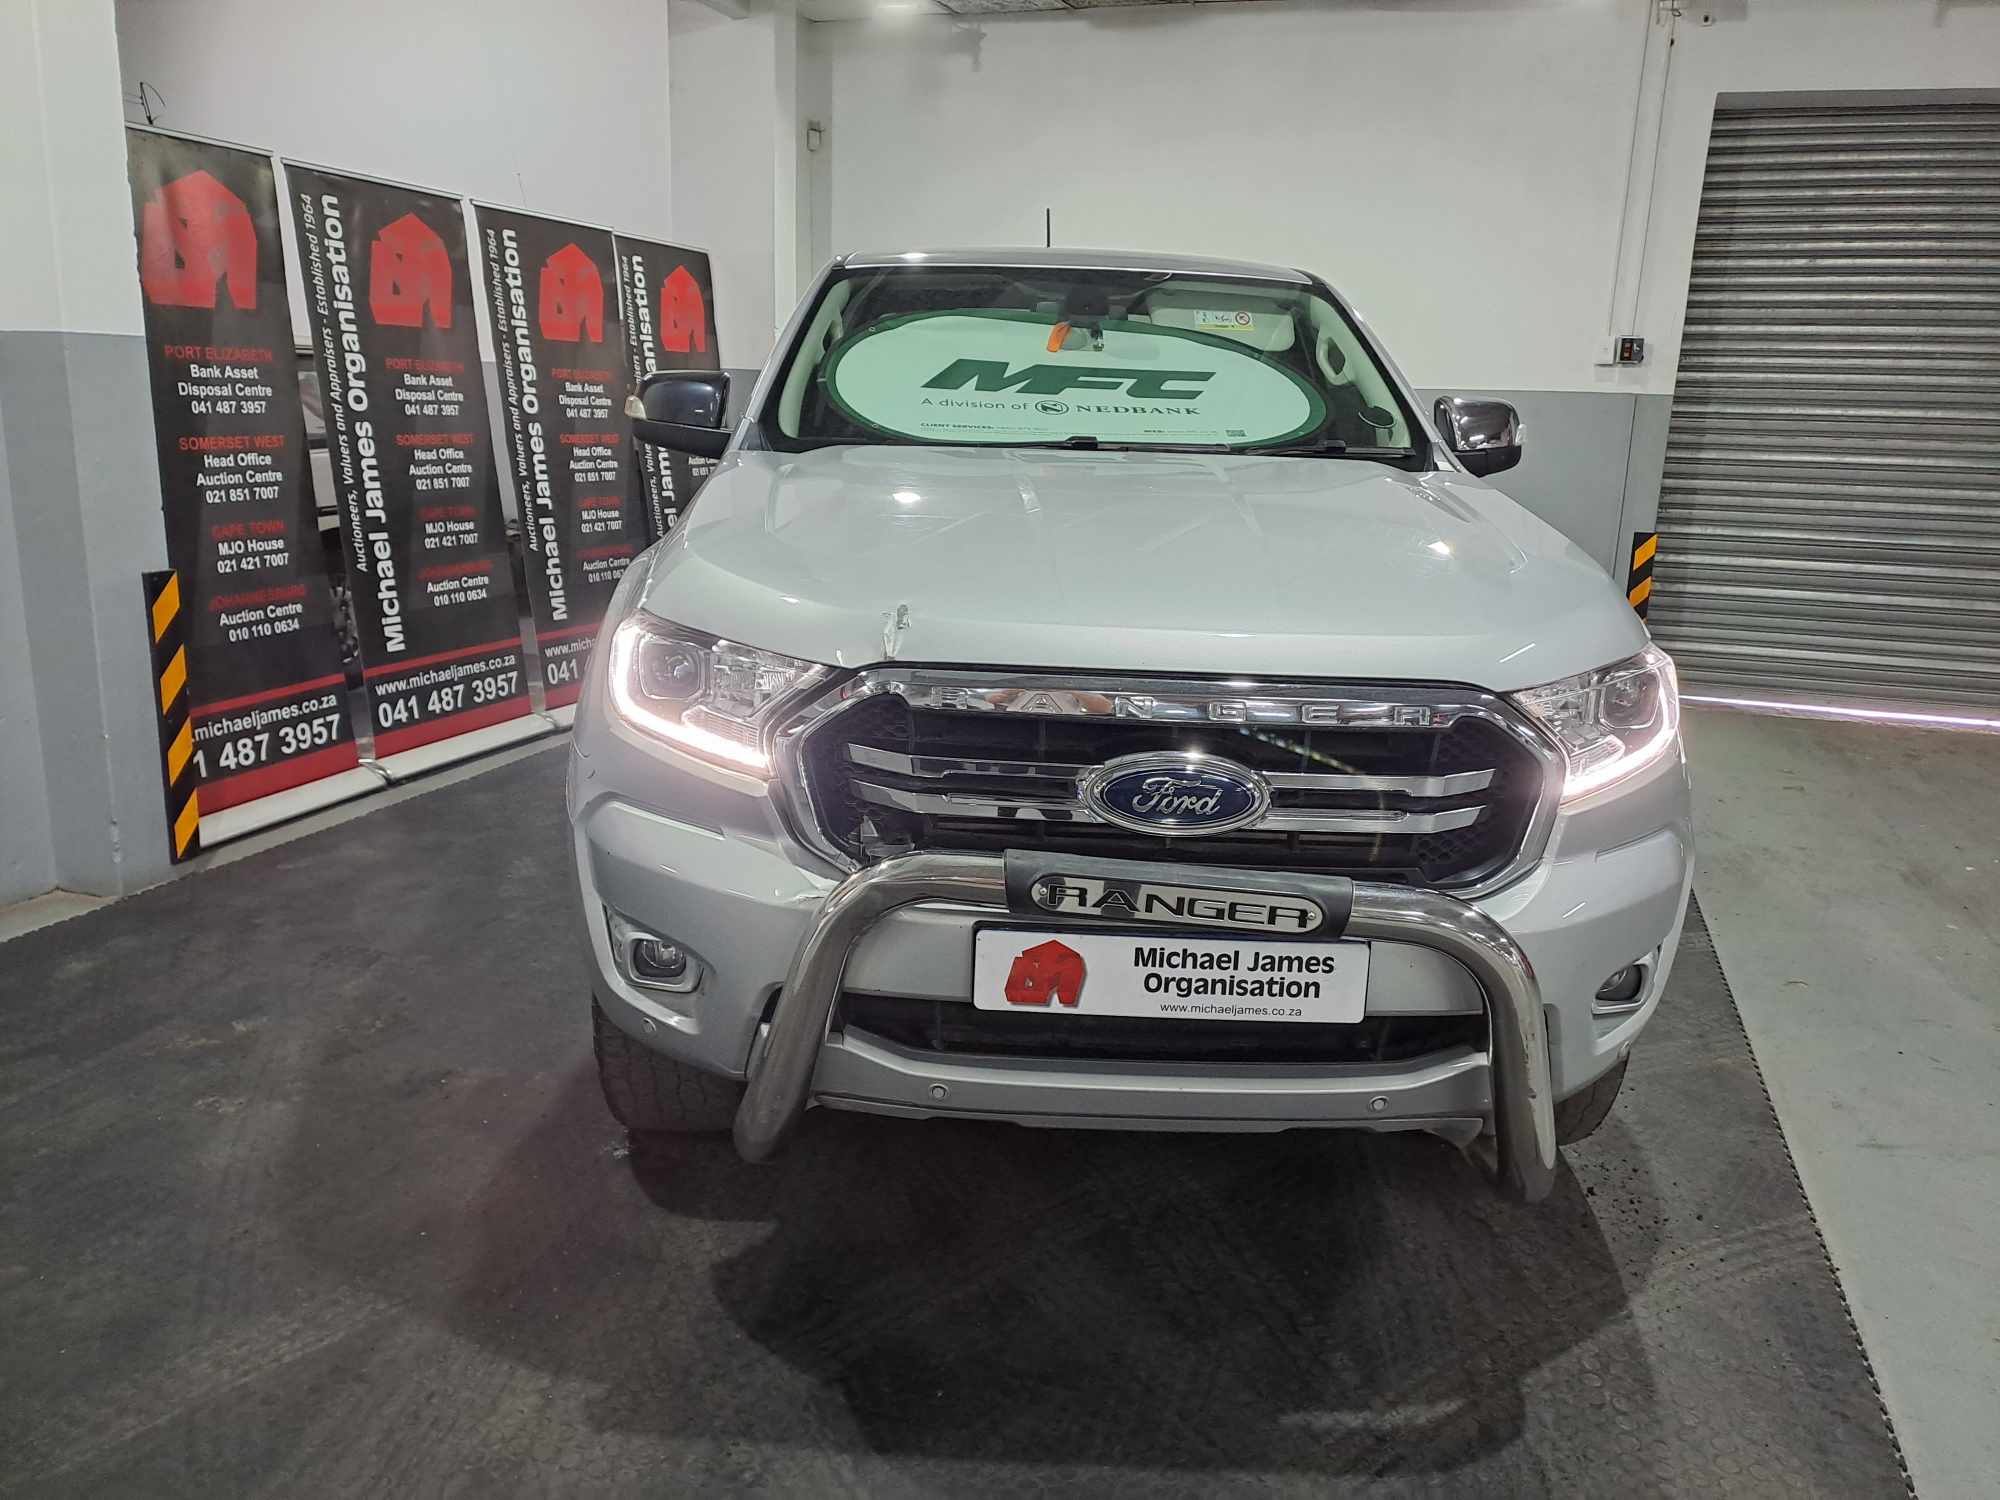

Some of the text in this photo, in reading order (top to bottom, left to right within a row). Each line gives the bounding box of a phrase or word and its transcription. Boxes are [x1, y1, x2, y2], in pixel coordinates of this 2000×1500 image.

[300, 193, 316, 229] 1964
[486, 229, 499, 261] 1964
[306, 230, 329, 315] Established
[489, 262, 508, 332] Established
[164, 345, 199, 359] PORT
[322, 326, 343, 402] Appraisers
[190, 364, 258, 379] Bank Asset
[404, 374, 453, 387] Bank Asset
[502, 341, 518, 404] Appraisers
[920, 358, 1216, 400] MFC
[177, 382, 272, 398] Disposal Centre
[395, 388, 464, 402] Disposal Centre
[191, 401, 266, 414] 041 487 3957
[331, 403, 347, 431] and
[405, 404, 459, 416] 041 487 3957
[566, 408, 578, 418] 041
[921, 398, 1200, 415] A division of NEDBANK
[321, 194, 406, 653] Michael James Organisation
[502, 229, 568, 621] Michael James Organisation
[508, 407, 521, 431] and
[179, 435, 285, 450] SOMERSET WEST
[414, 448, 464, 460] Head Office
[204, 453, 272, 468] Head Office
[339, 434, 354, 485] Valuers
[513, 433, 527, 477] Valuers
[196, 470, 283, 486] Auction Centre
[409, 463, 473, 476] Auction Centre
[206, 486, 279, 503] 021 851 7007
[416, 477, 470, 490] 021 851 7007
[521, 480, 539, 551] Auctioneers,
[582, 510, 596, 520] MJO
[346, 488, 368, 573] Auctioneers,
[425, 521, 474, 534] MJO House
[218, 539, 284, 555] MJO House
[425, 533, 478, 549] 021 421 7007
[217, 553, 289, 573] 021 421 7007
[426, 576, 489, 593] Auction Centre
[434, 588, 487, 607] 010 110 0634
[220, 602, 302, 626] Auction Centre
[229, 618, 300, 642] 010 110 0634
[375, 654, 516, 696] www.michaeljames.co.za
[547, 658, 578, 684] 041
[378, 671, 518, 728] 041 487 3957
[929, 686, 1433, 726] RANGER
[219, 733, 269, 770] 487
[279, 713, 340, 754] 3957
[1132, 776, 1223, 816] Ford
[1048, 883, 1309, 929] RANGER
[1133, 946, 1335, 974] Michael James
[1143, 972, 1321, 998] Organisation
[1160, 1002, 1302, 1017] www.michaeljames.co.za
